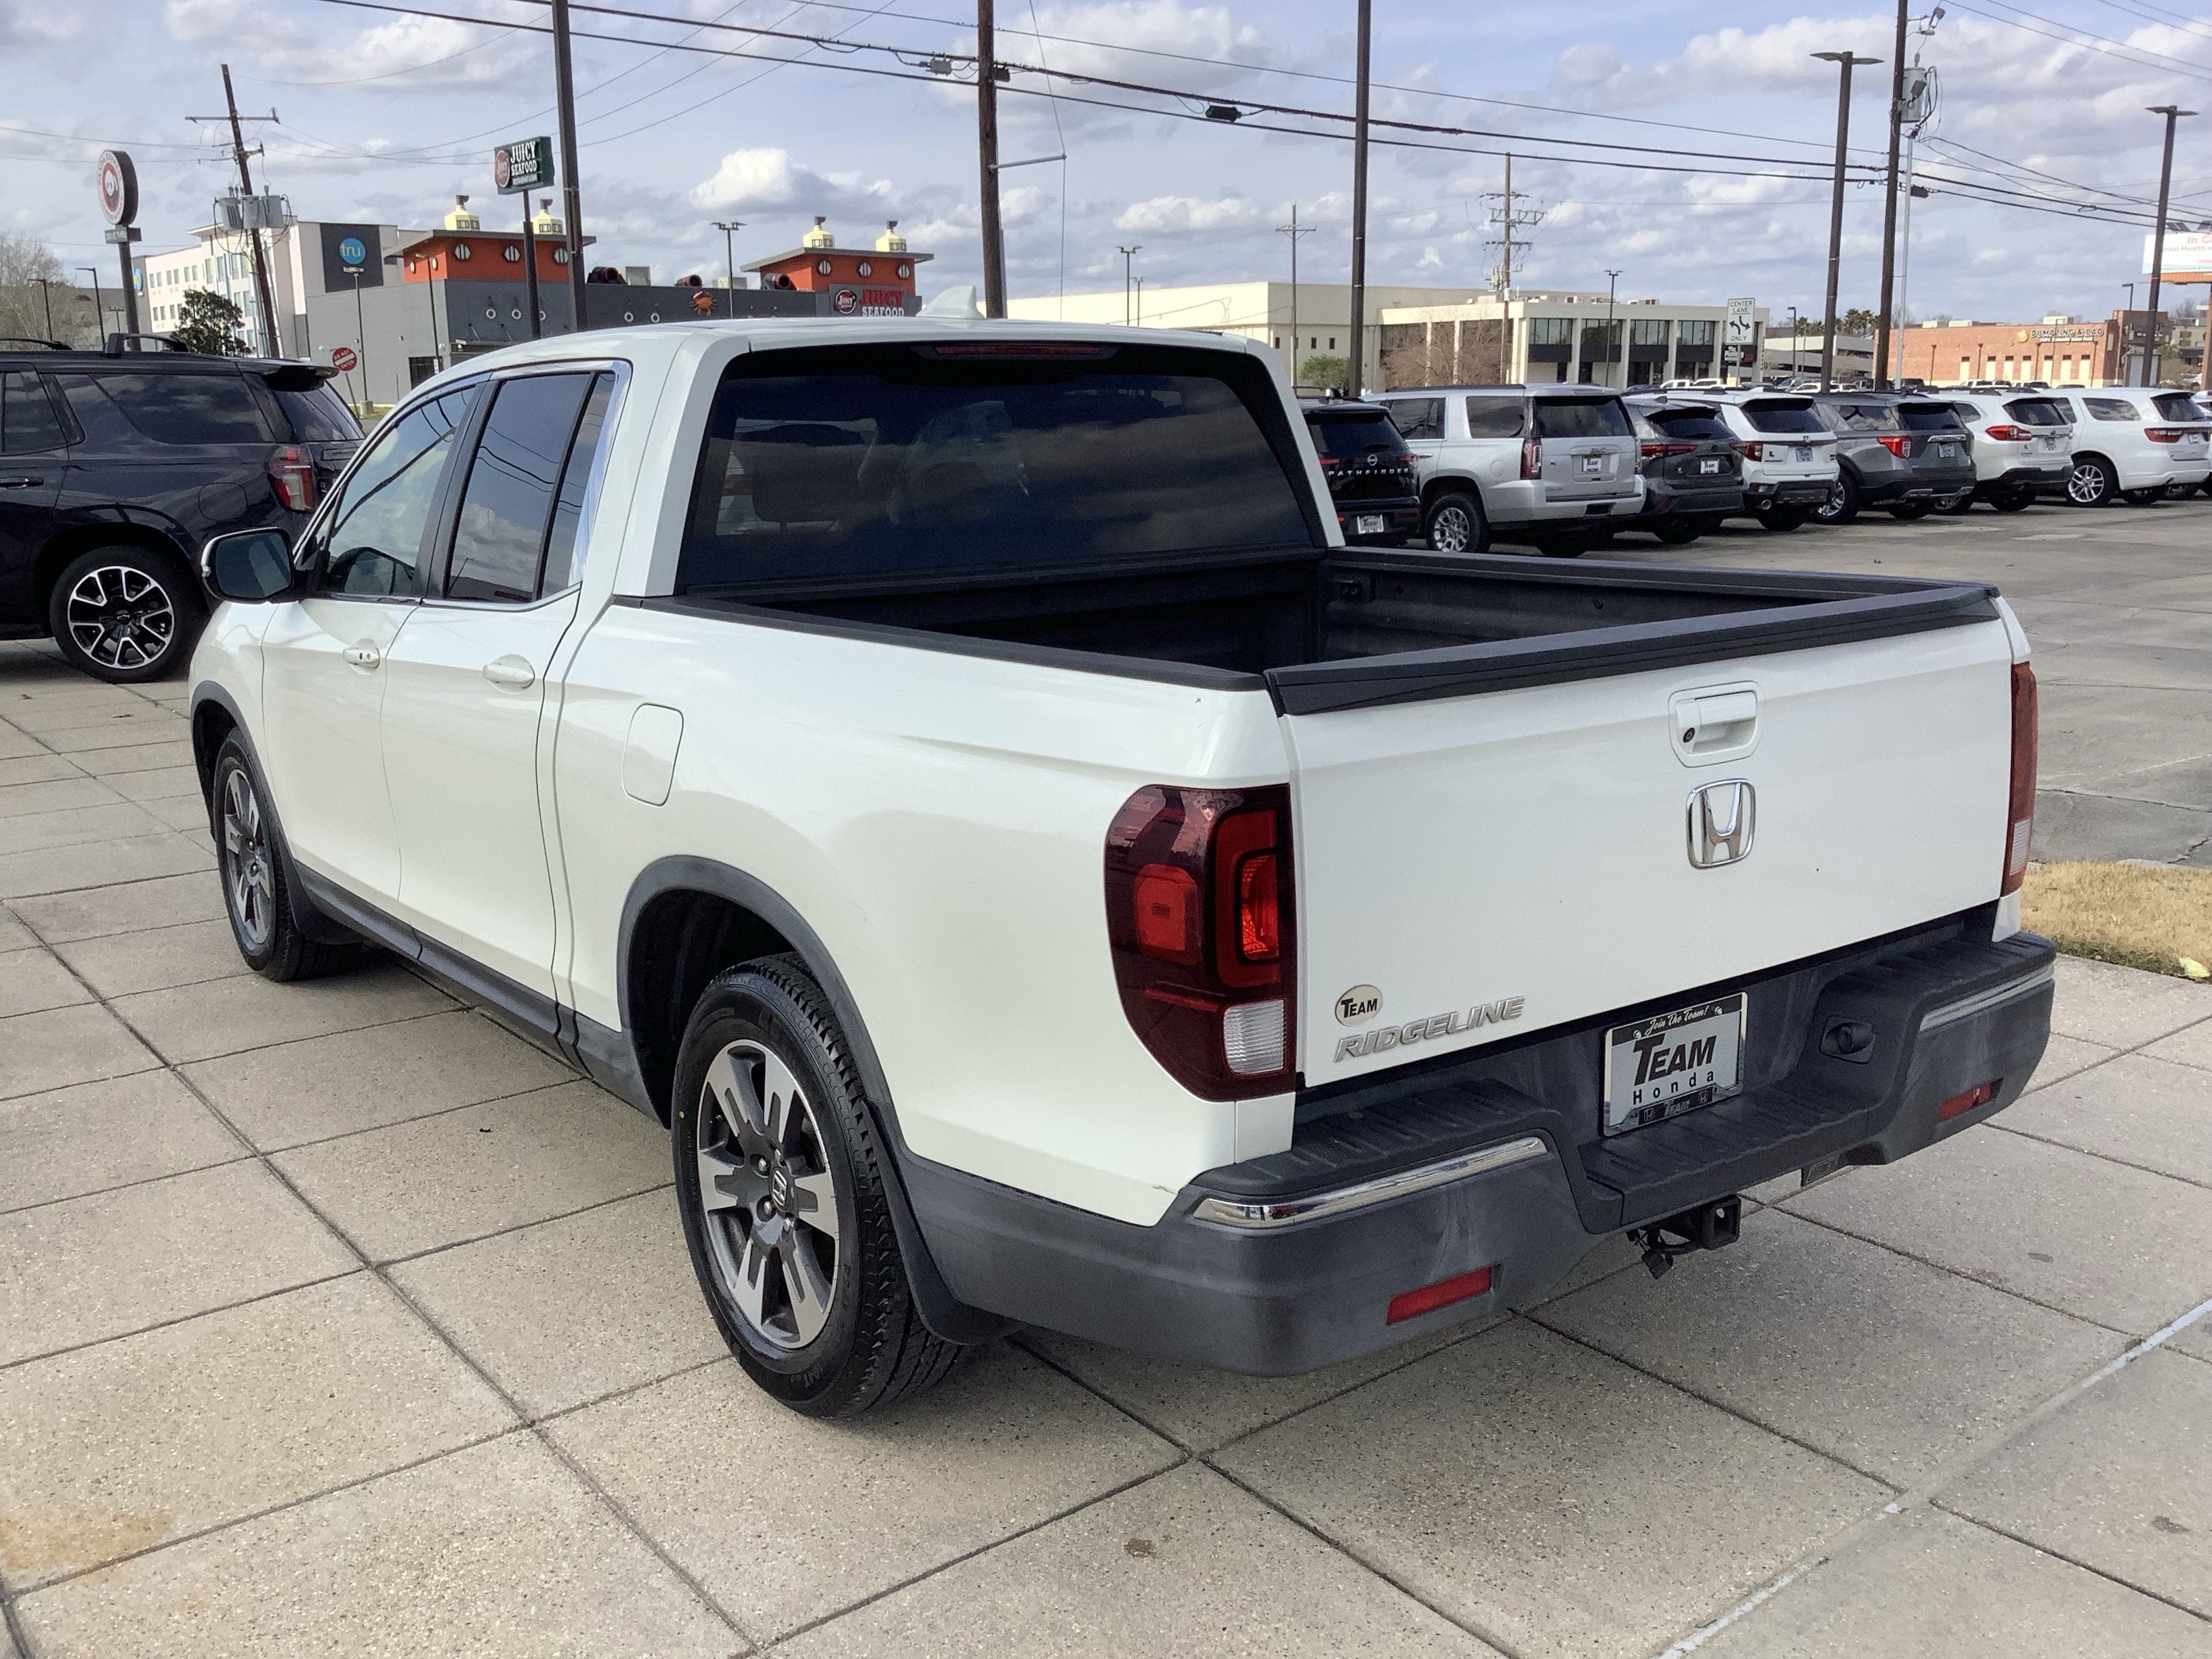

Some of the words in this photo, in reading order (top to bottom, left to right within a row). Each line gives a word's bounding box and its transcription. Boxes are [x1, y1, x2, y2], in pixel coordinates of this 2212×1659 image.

[510, 141, 536, 163] JUICY
[511, 159, 537, 176] SEAFOOD
[340, 243, 361, 258] tru
[859, 289, 904, 306] JUICY
[862, 306, 905, 317] SEAFOOD
[2031, 329, 2075, 337] DUMPLING
[2085, 328, 2104, 336] BAO
[1328, 468, 1410, 476] PATHFINDER
[1340, 998, 1378, 1019] TEAM
[1333, 995, 1525, 1063] RIDGELINE
[1645, 1019, 1666, 1036] Join
[1667, 1013, 1681, 1027] The
[1683, 1005, 1710, 1021] Team!
[1633, 1033, 1717, 1086] TEAM
[1633, 1071, 1714, 1105] Honda
[1664, 1099, 1691, 1116] TEAM
